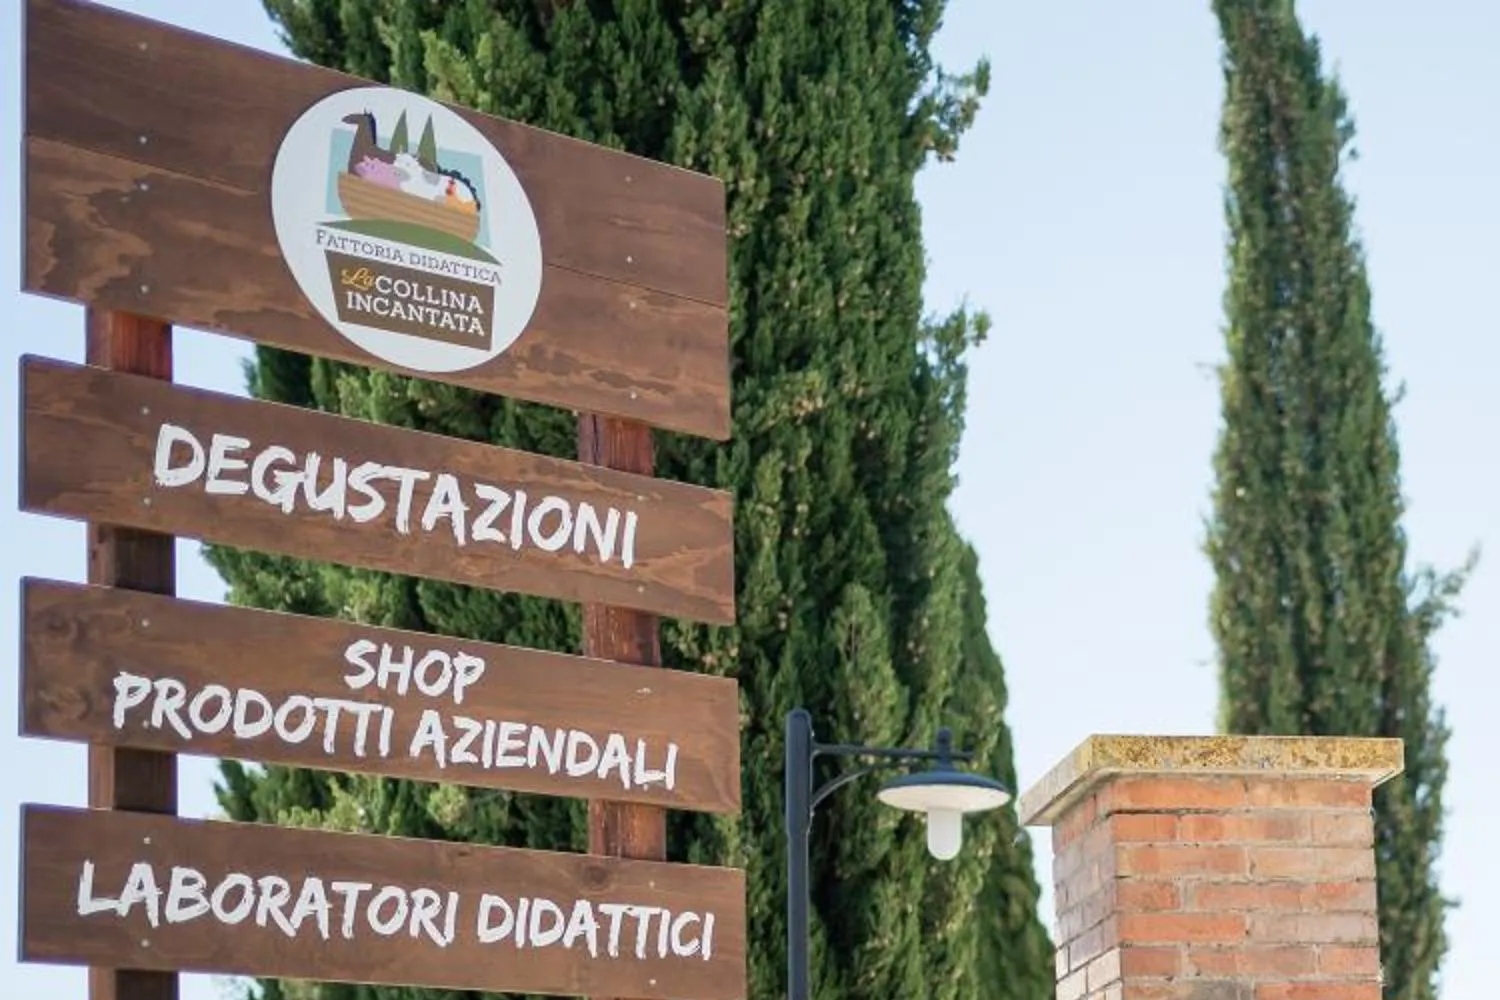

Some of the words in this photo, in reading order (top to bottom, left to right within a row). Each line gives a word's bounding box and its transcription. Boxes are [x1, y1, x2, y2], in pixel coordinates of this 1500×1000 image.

[315, 229, 404, 263] FATTORIA
[409, 252, 502, 286] DIDATTICA
[341, 267, 374, 291] La
[375, 275, 484, 314] COLLINA
[346, 291, 485, 336] INCANTATA
[153, 423, 639, 569] DEGUSTAZIONI
[343, 638, 487, 704] SHOP
[111, 670, 393, 757] PRODOTTI
[409, 710, 679, 791] AZIENDALI
[76, 860, 459, 947] LABORATORI
[477, 893, 715, 961] DIDATTICI
